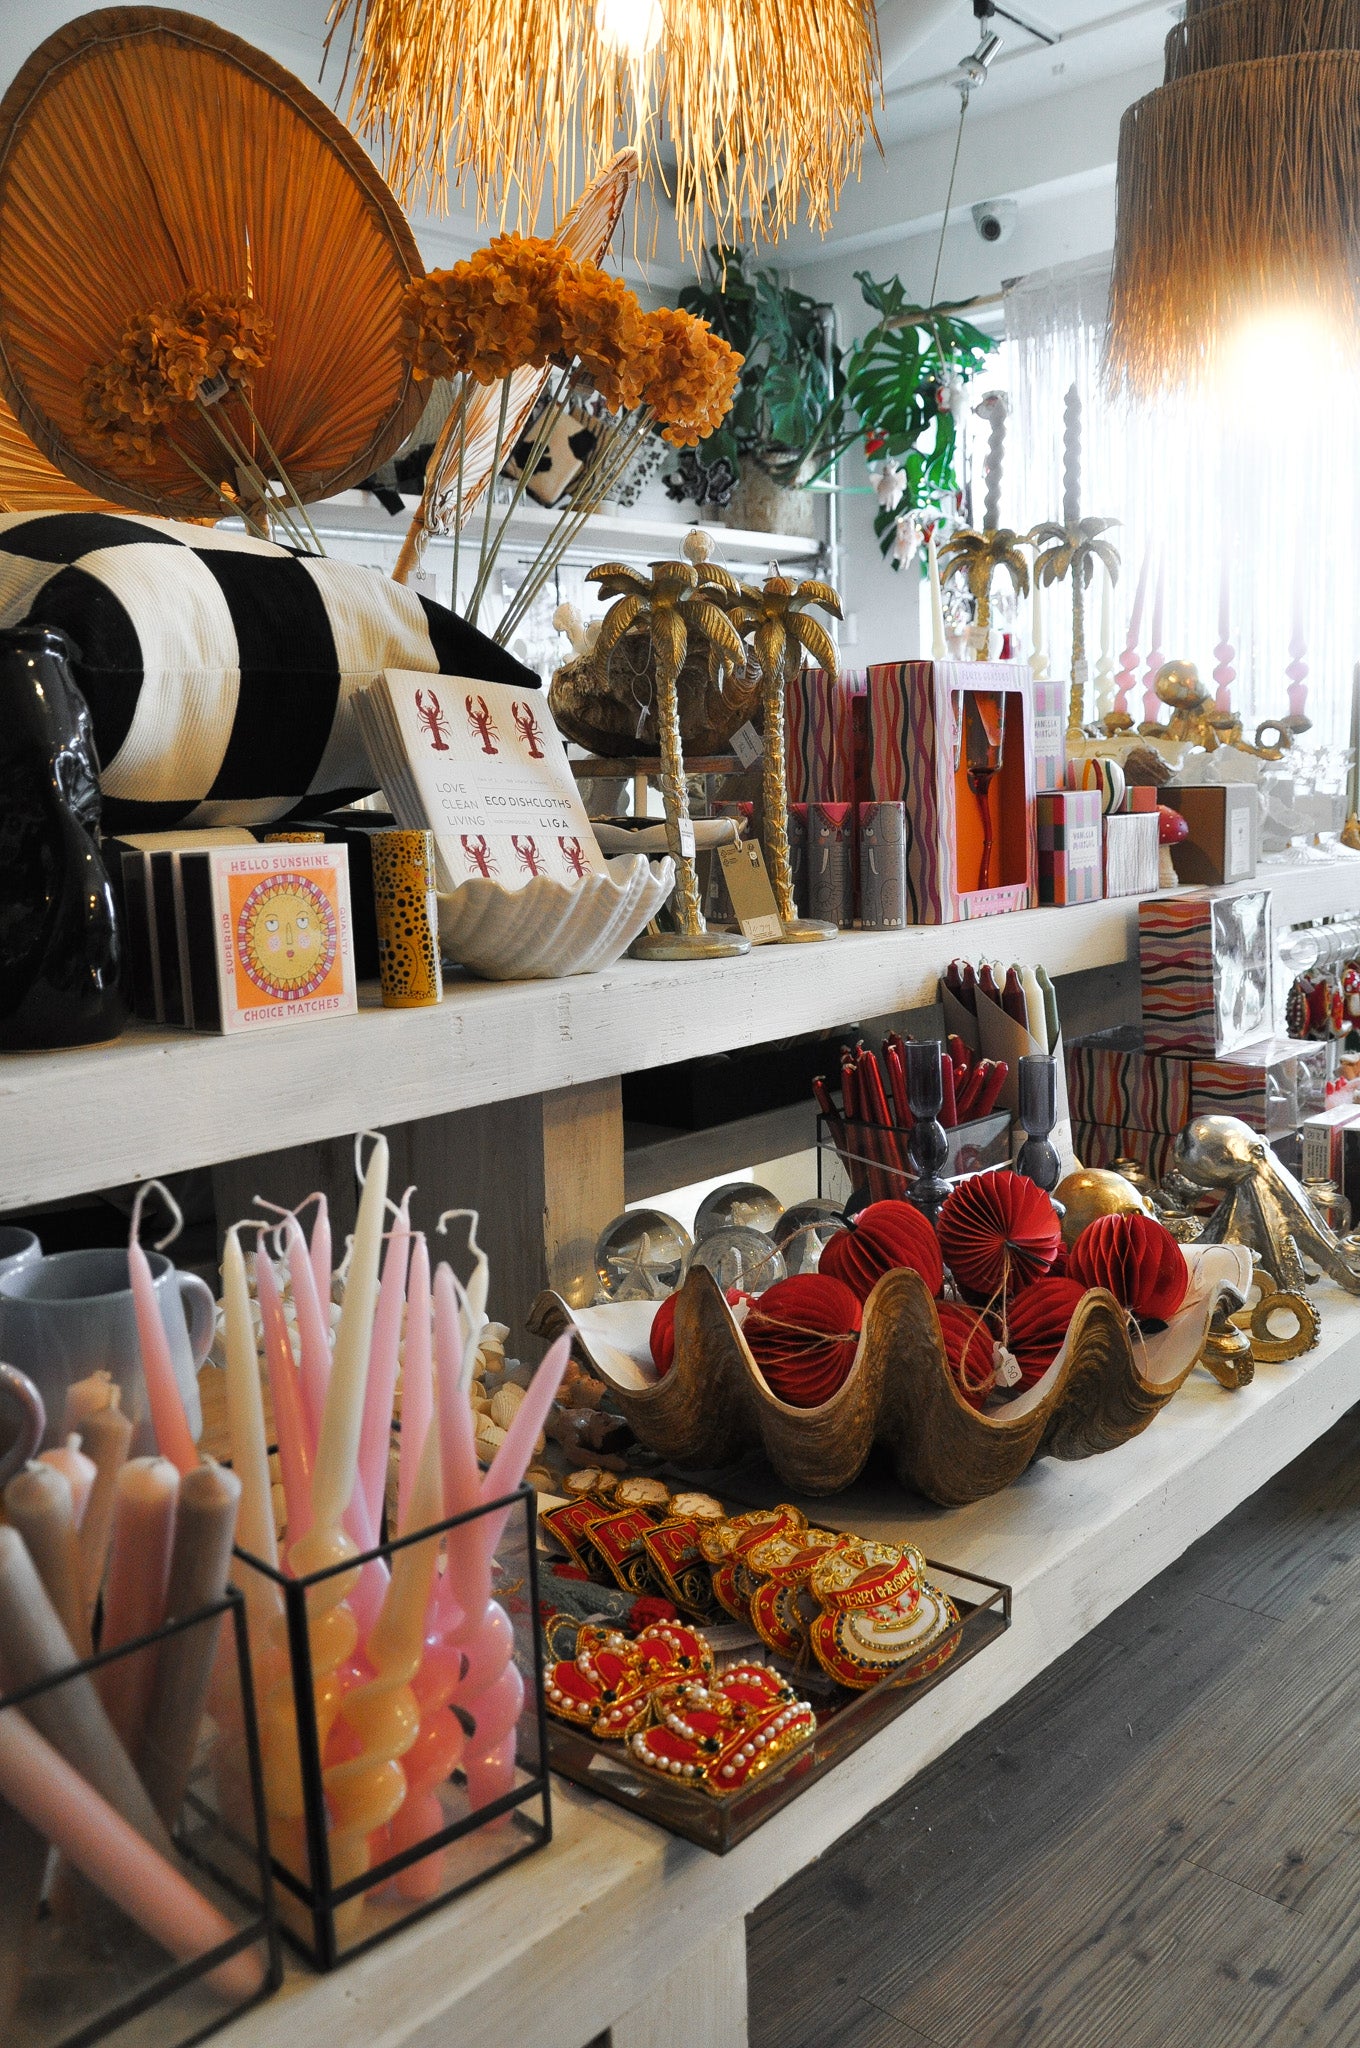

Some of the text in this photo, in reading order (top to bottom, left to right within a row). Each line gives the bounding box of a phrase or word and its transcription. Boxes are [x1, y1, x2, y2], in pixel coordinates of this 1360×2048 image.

[435, 782, 467, 793] LOVE
[441, 798, 479, 809] CLEAN
[484, 795, 572, 809] ECO DISHCLOTHS
[446, 815, 485, 826] LIVING
[539, 818, 569, 828] LIGA
[231, 855, 330, 871] HELLO SUNSHINE
[339, 906, 348, 956] QUALITY
[222, 913, 234, 974] SUPERIOR
[243, 998, 339, 1022] CHOICE MATCHES
[836, 1588, 875, 1607] MERRY
